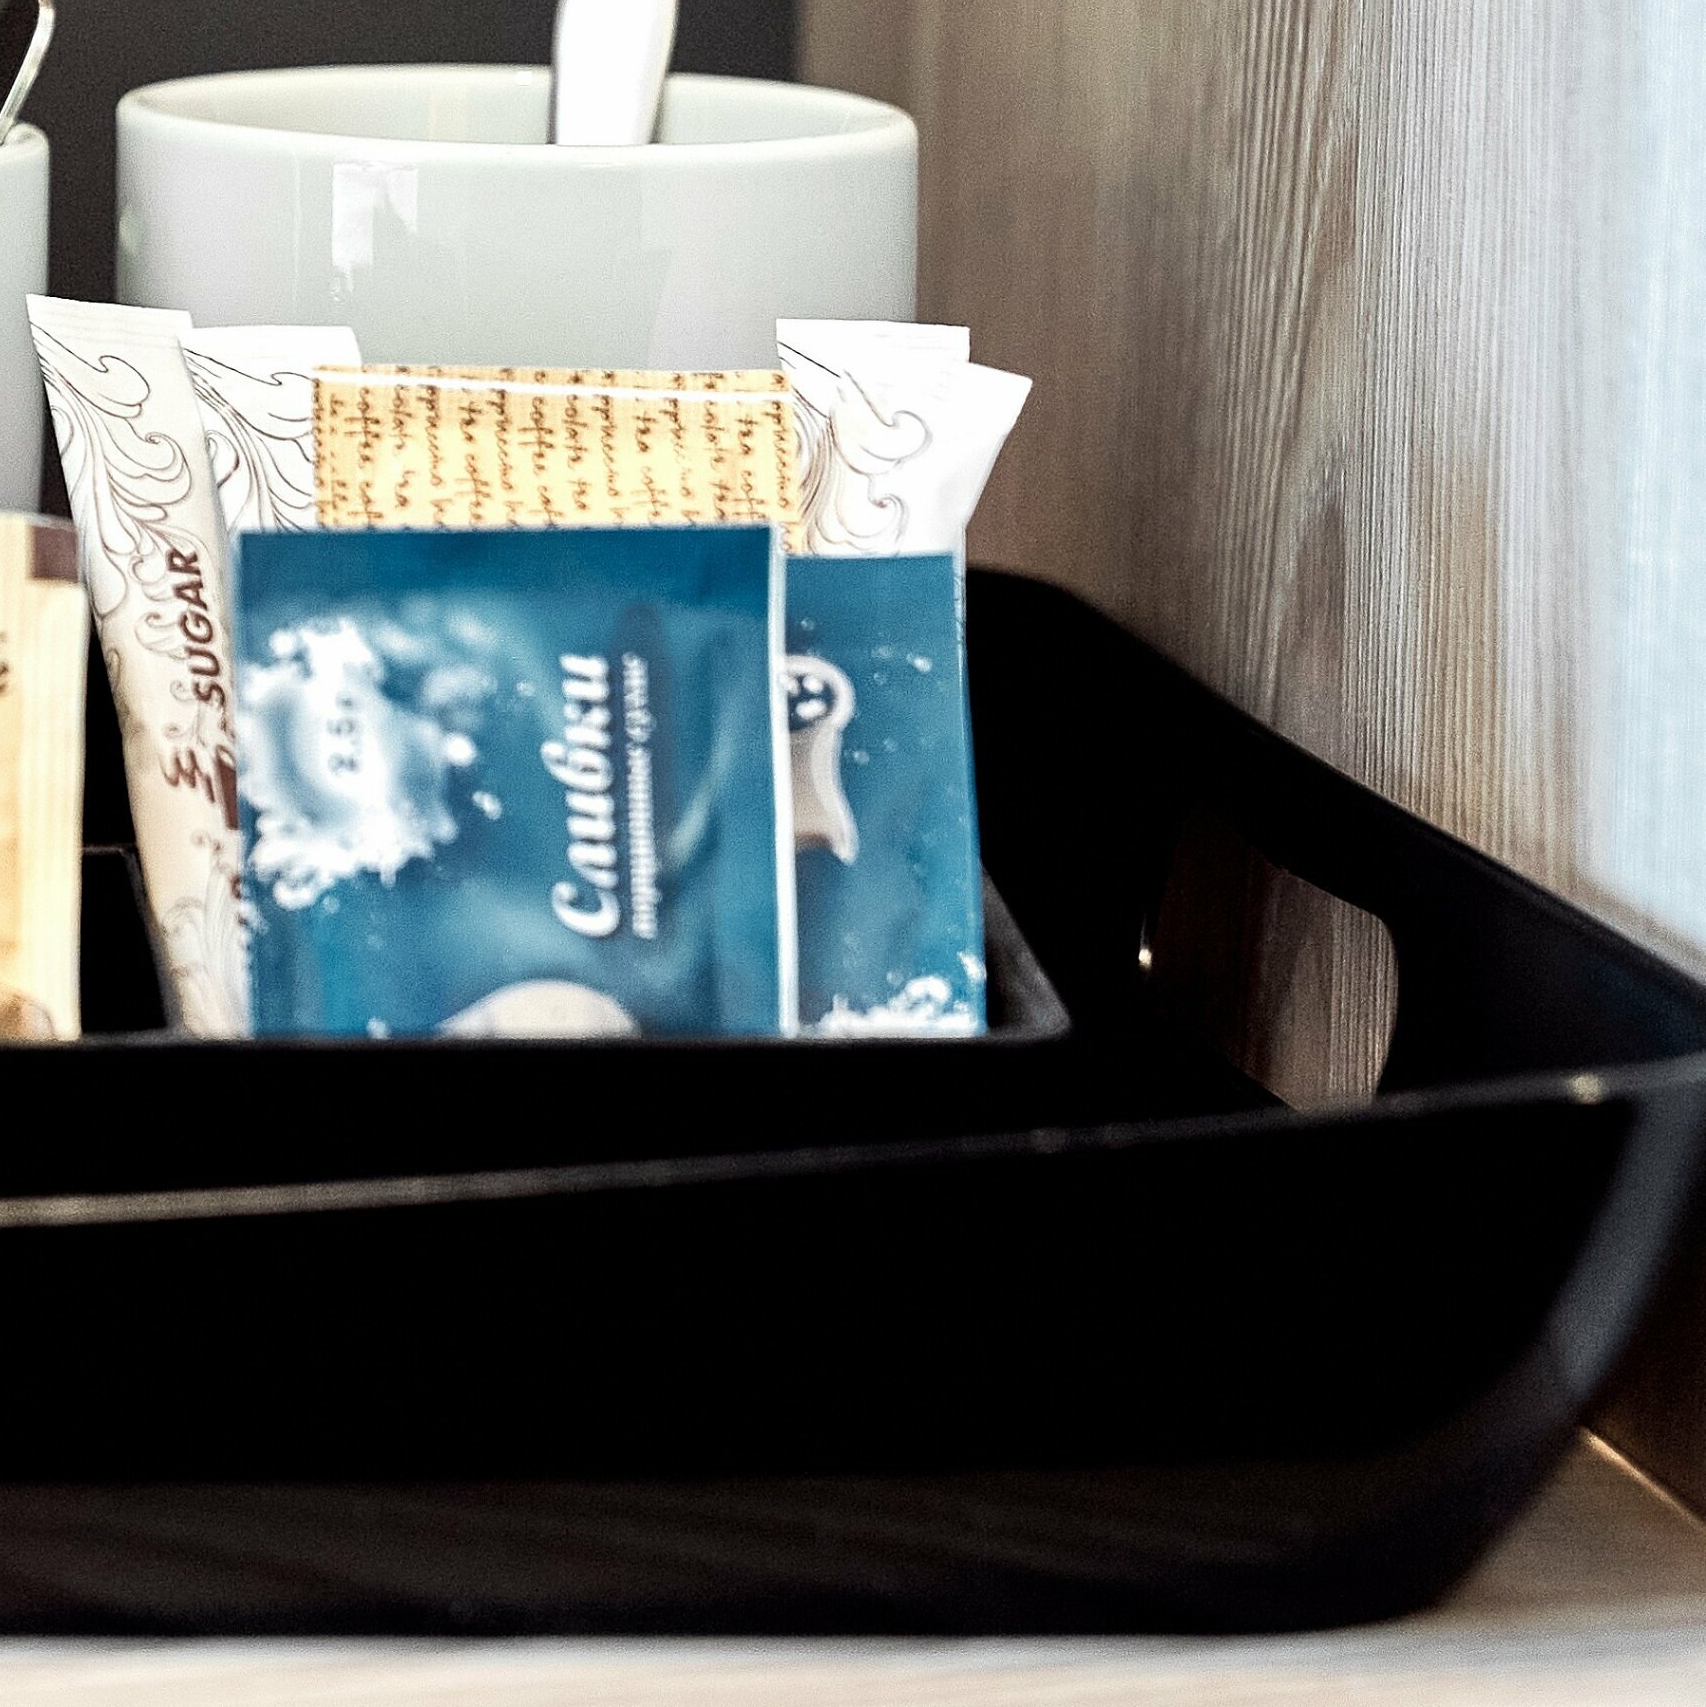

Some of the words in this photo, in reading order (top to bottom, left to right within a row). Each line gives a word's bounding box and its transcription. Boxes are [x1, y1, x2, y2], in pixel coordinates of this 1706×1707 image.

[348, 482, 383, 530] caf
[530, 485, 564, 528] caf
[732, 469, 767, 522] coff
[164, 546, 227, 708] SUGAR
[540, 652, 623, 939] Сливки
